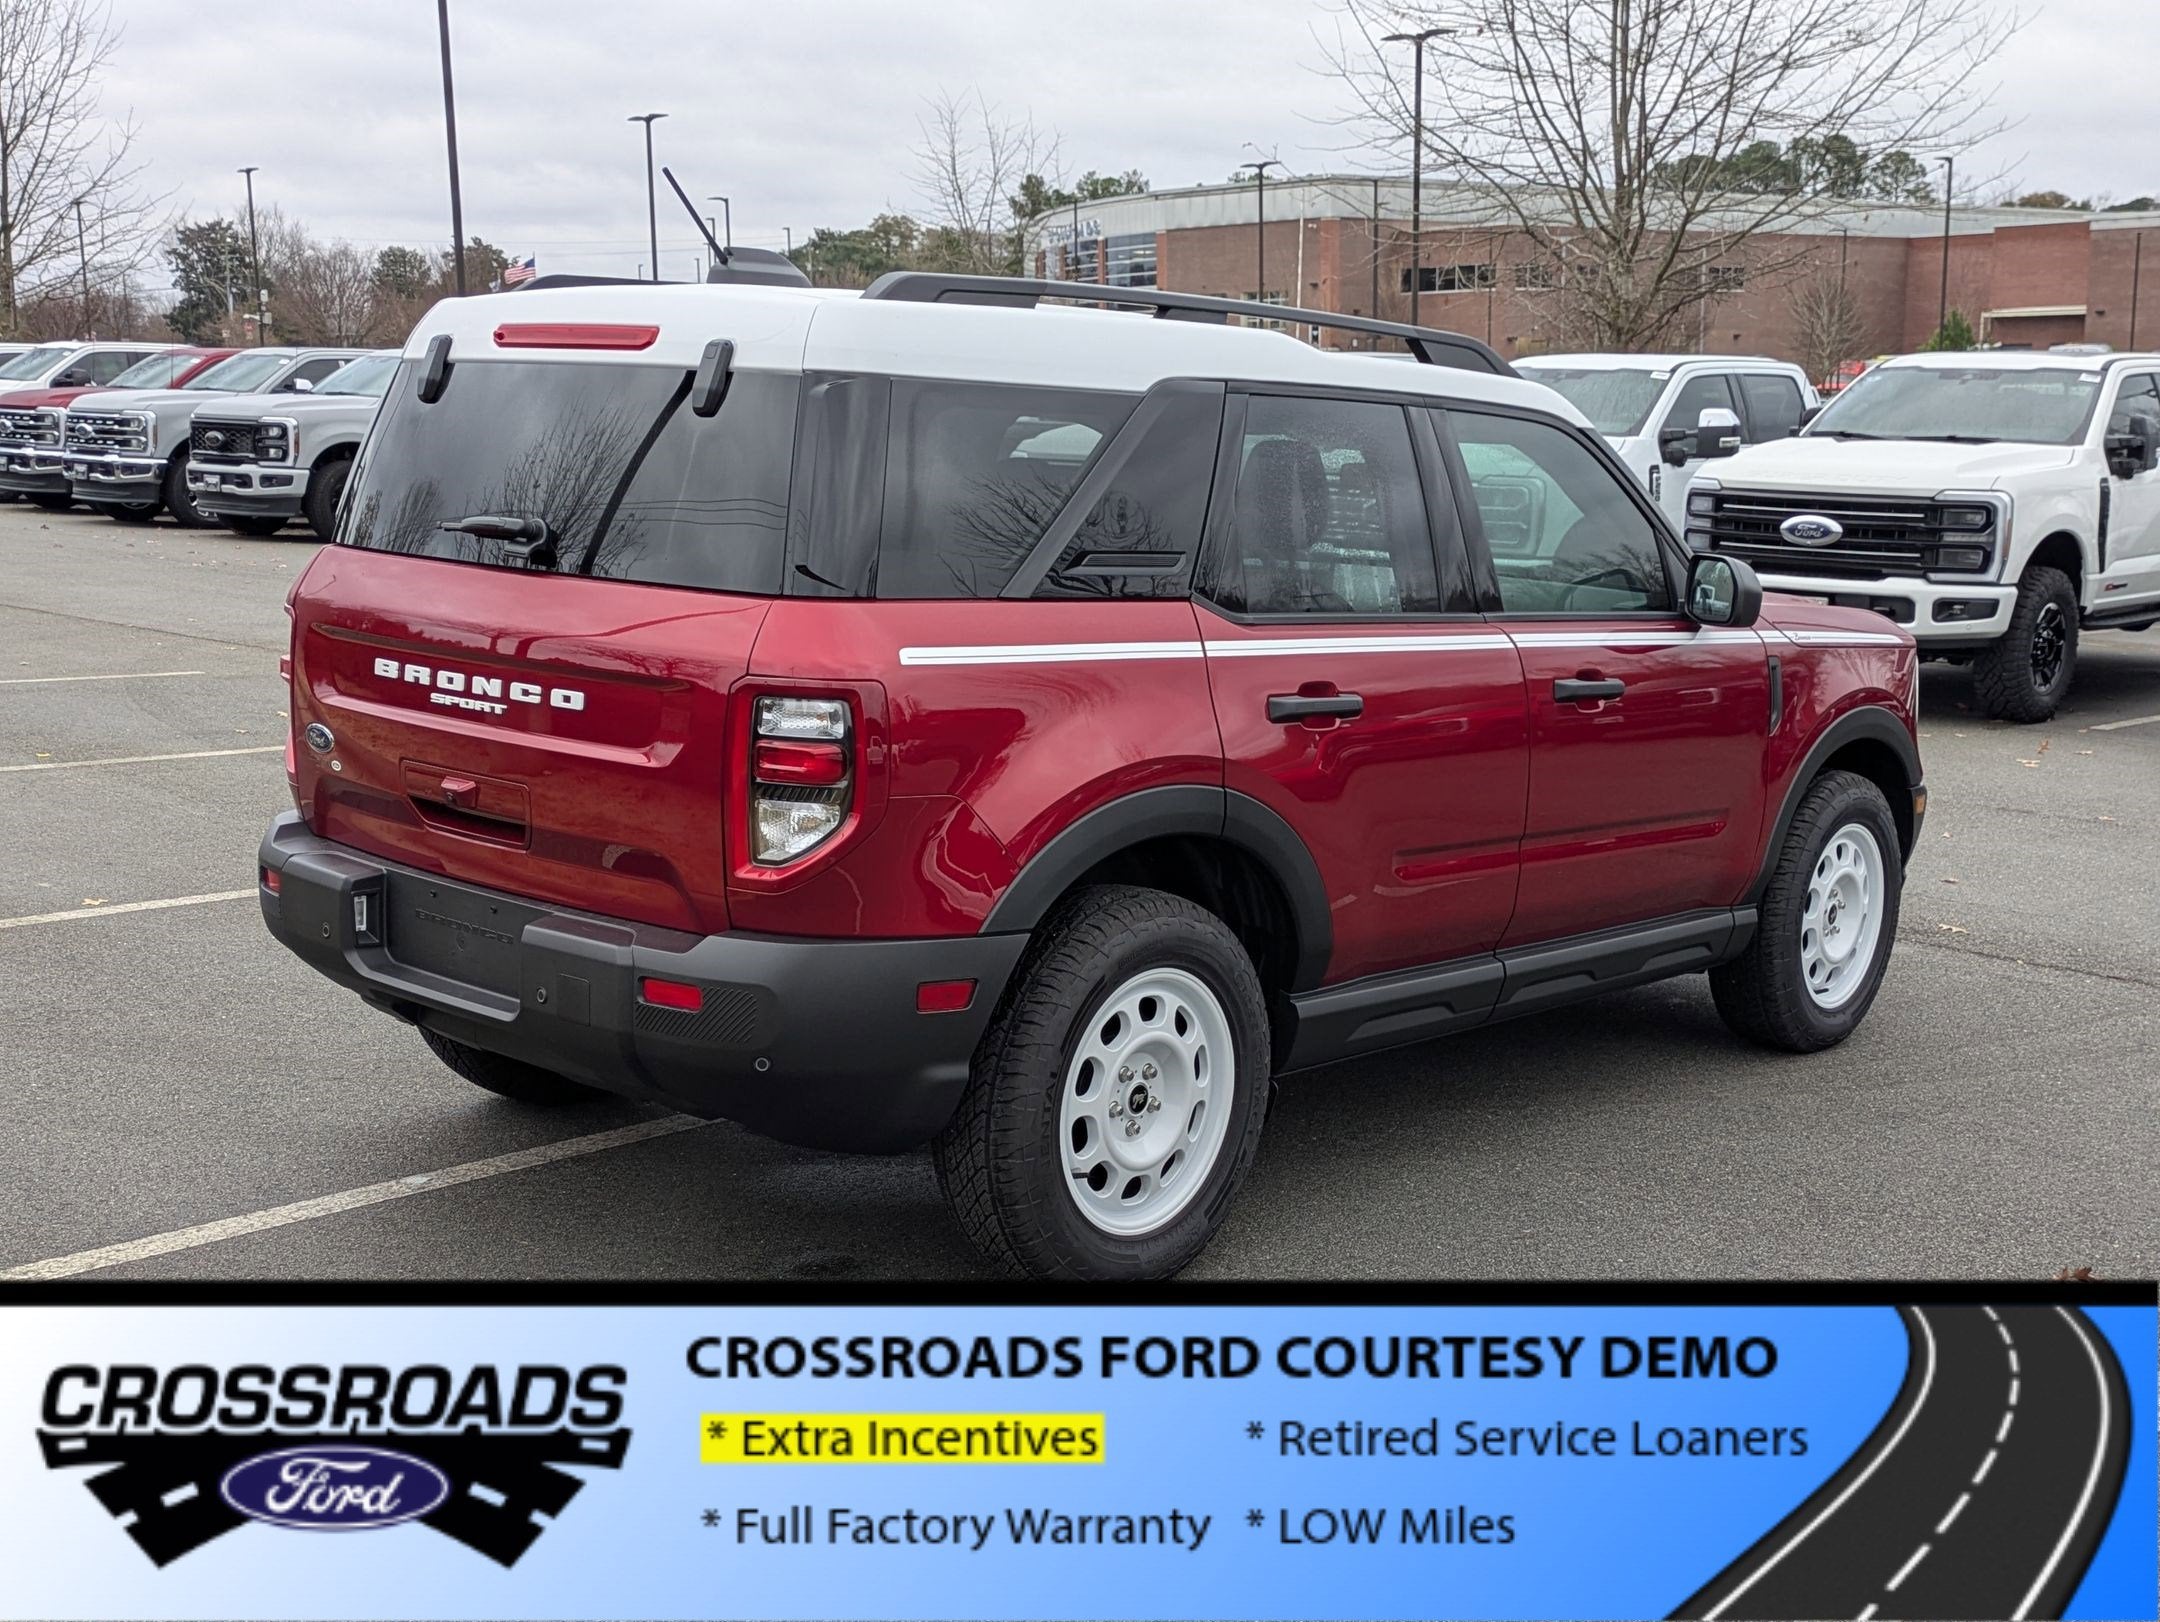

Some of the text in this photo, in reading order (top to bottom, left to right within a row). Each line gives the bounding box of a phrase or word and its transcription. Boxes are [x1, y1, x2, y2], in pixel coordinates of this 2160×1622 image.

[1794, 523, 1824, 538] Ford
[374, 657, 585, 711] BRONCO
[430, 692, 508, 714] SPORT
